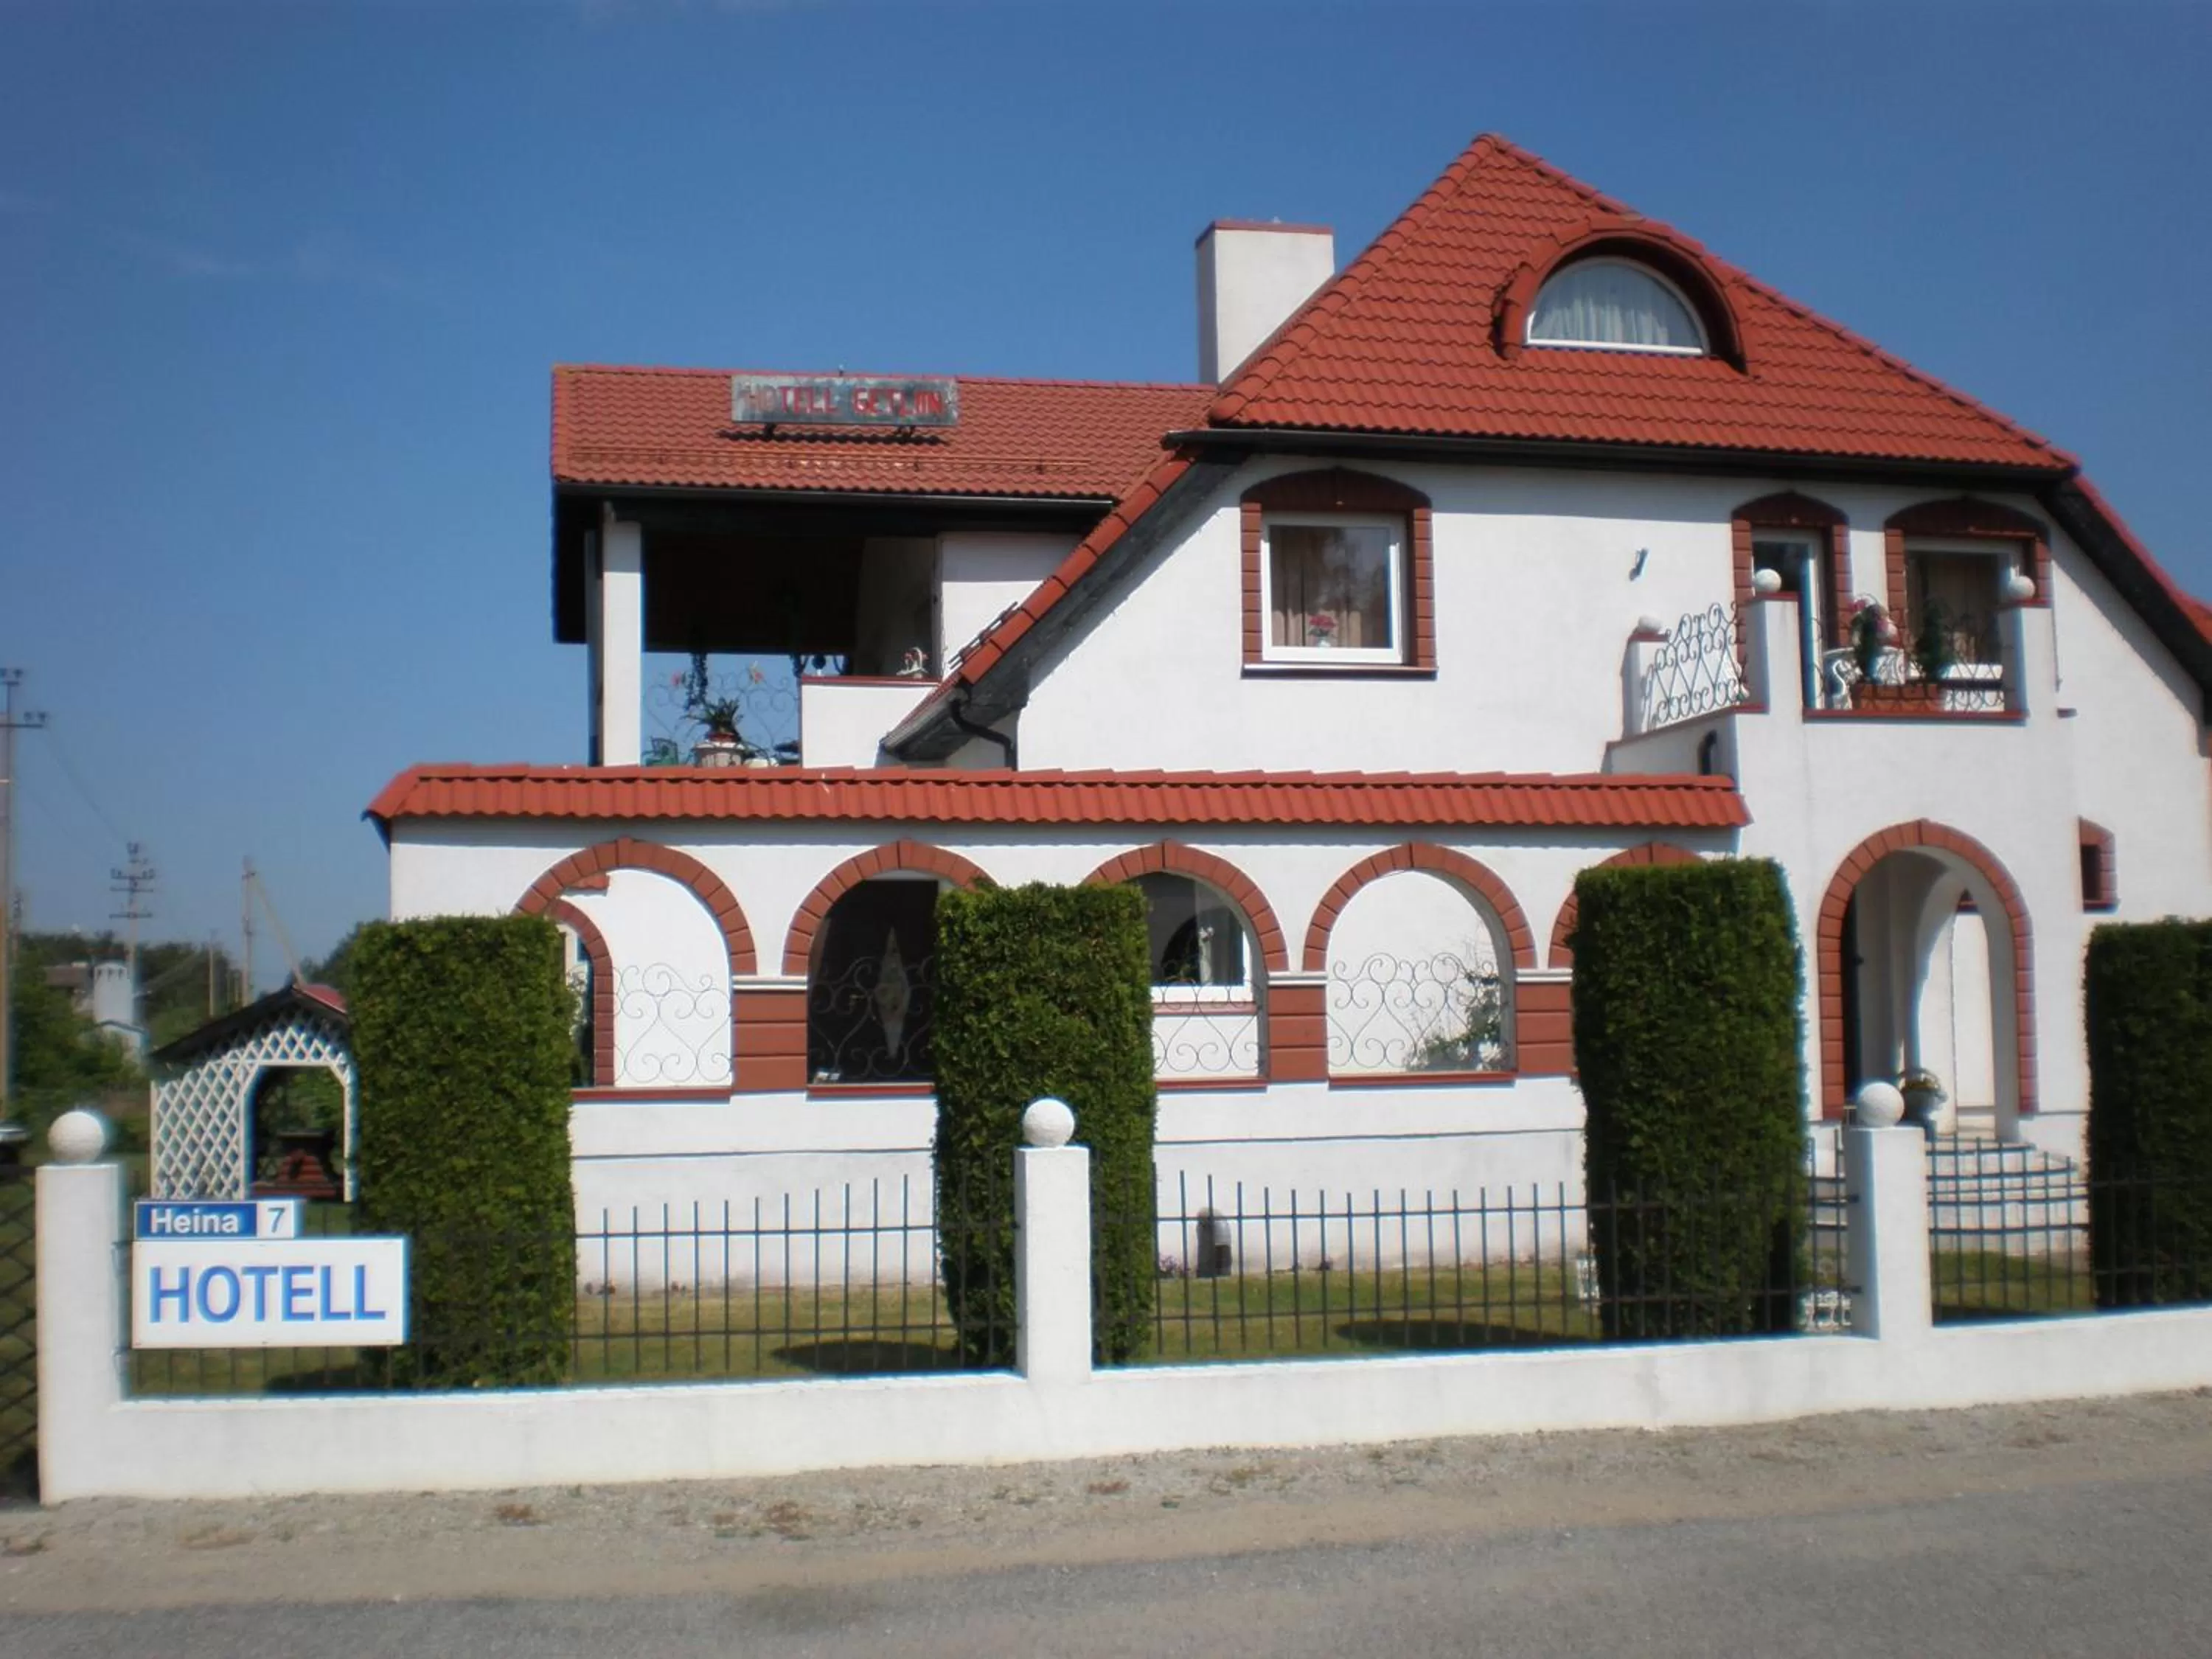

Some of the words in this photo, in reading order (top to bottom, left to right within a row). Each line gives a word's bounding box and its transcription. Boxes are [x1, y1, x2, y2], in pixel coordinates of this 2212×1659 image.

[150, 1208, 239, 1234] Heina
[268, 1207, 285, 1234] 7
[149, 1265, 386, 1323] HOTELL
